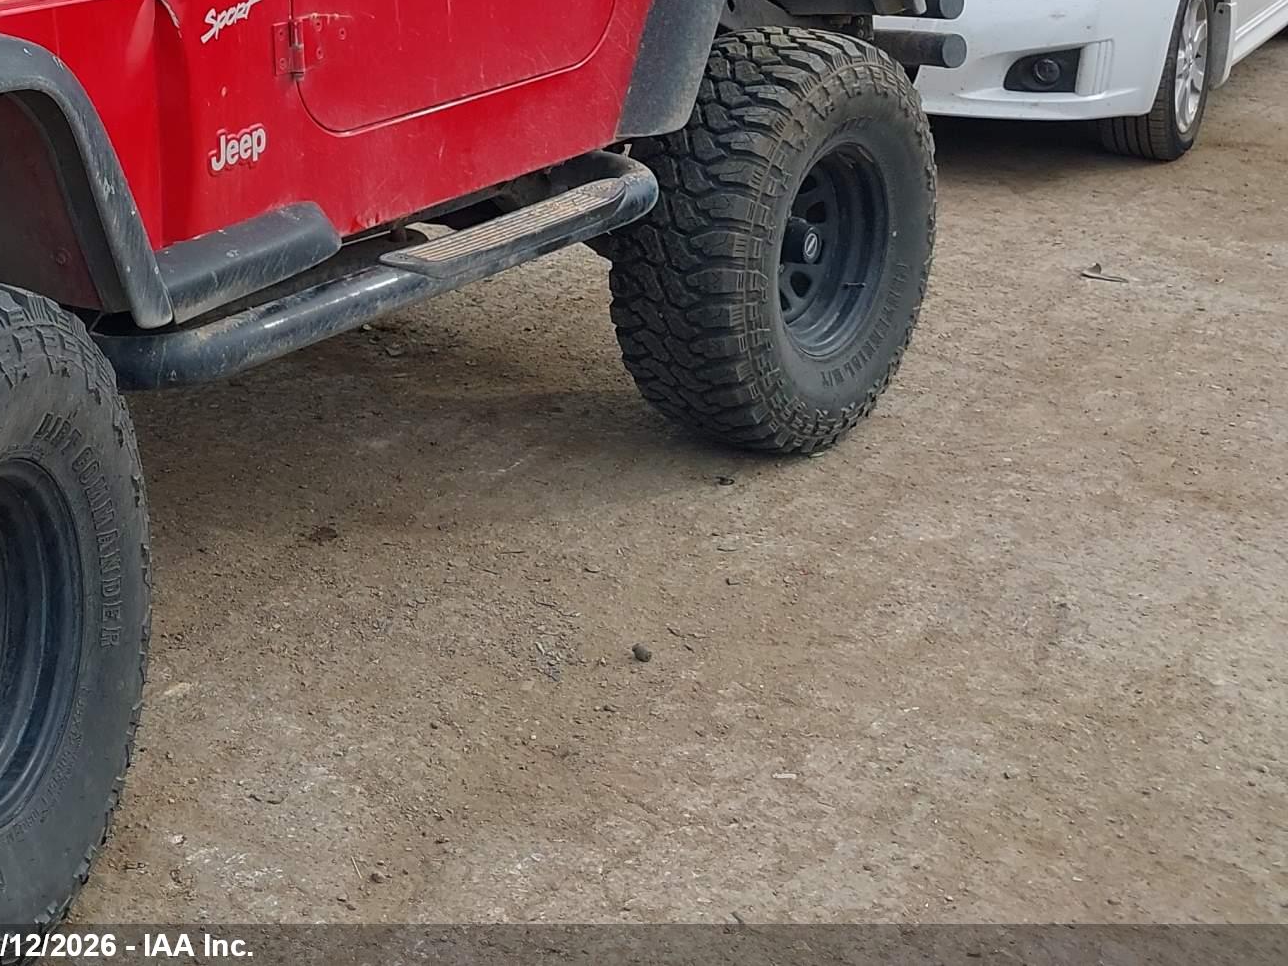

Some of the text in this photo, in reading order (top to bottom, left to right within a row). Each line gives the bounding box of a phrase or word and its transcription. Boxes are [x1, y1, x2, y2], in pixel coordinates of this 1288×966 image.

[211, 127, 266, 172] Jeep
[36, 412, 123, 648] DIRT COMMANDER
